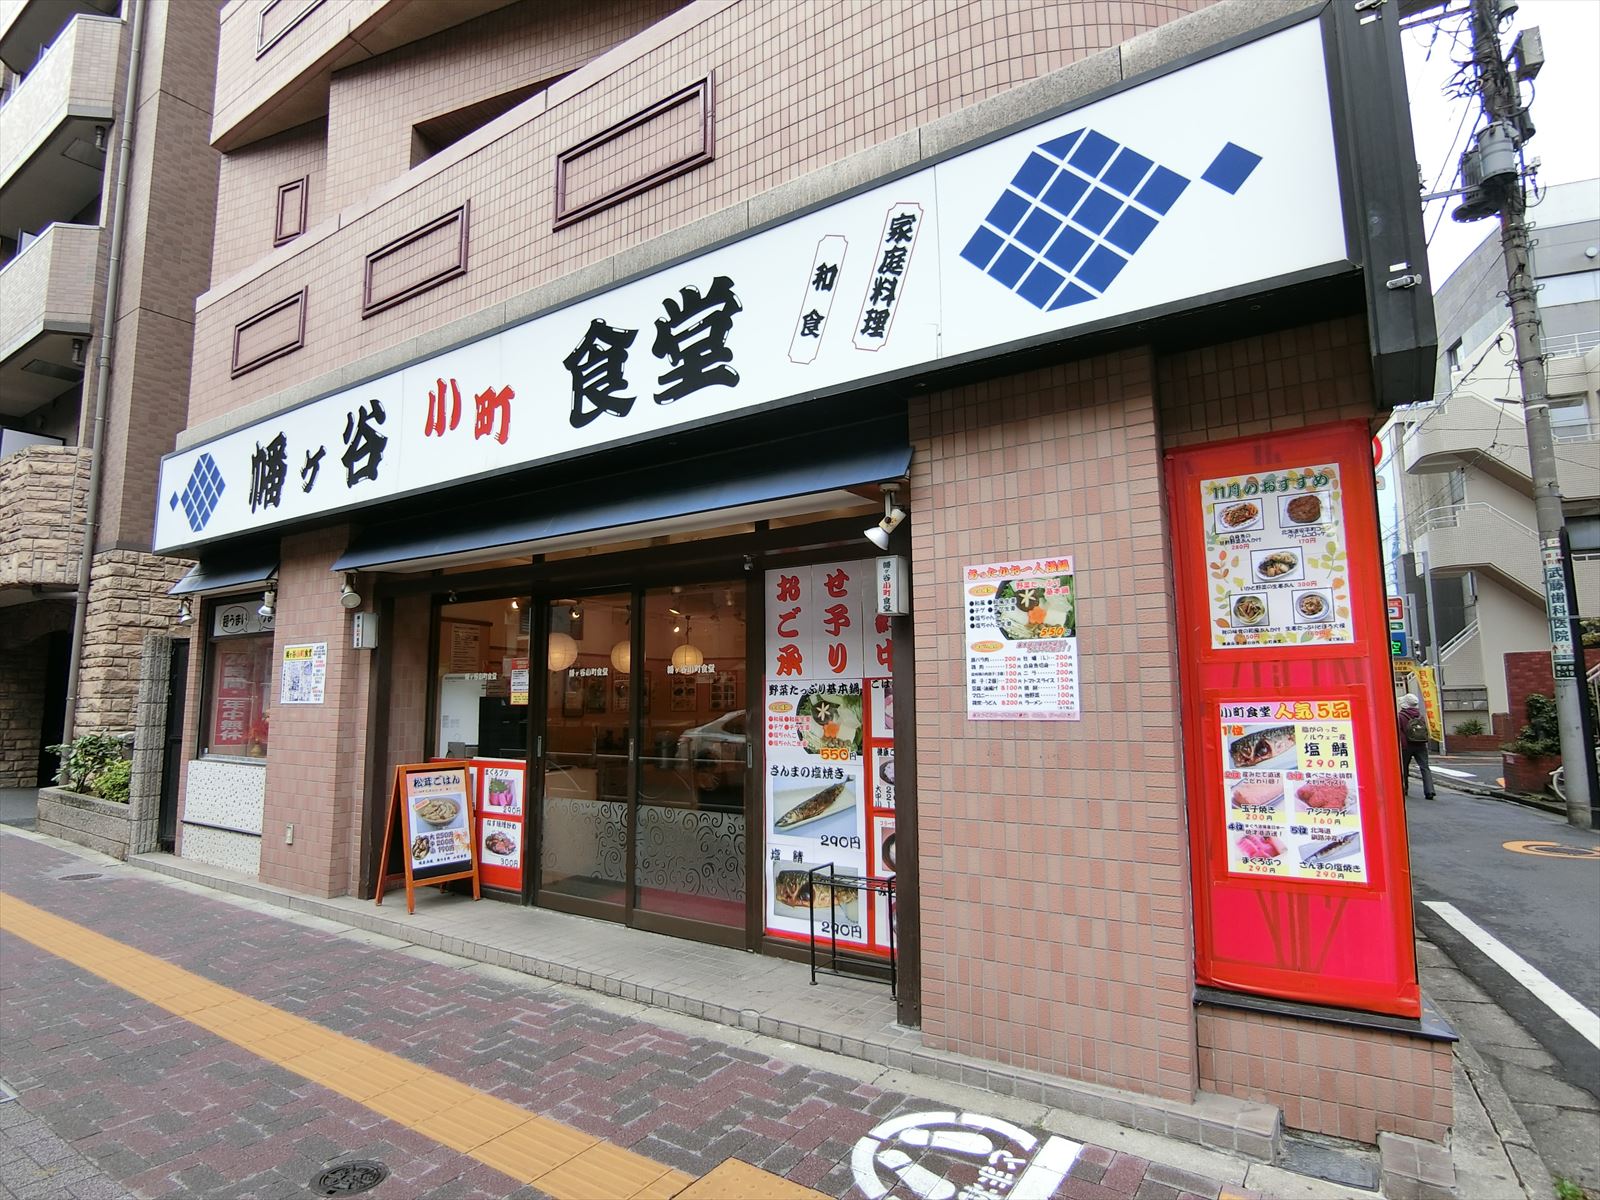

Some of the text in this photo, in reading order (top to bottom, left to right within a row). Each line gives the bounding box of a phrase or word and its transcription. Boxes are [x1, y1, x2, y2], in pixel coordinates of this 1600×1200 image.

[860, 212, 917, 338] 家庭料理
[800, 262, 838, 338] 和食
[248, 275, 744, 514] 幡ヶ谷 小町 食堂
[1213, 474, 1330, 500] 11月のおすすめ
[1548, 566, 1570, 642] 武藤歯科医院
[768, 683, 862, 697] 野菜たっぷり基本鍋
[1220, 706, 1272, 719] 小町食堂
[1222, 725, 1246, 737] 1位
[820, 748, 857, 761] 550円
[770, 765, 845, 780] さんまの塩焼き
[413, 775, 461, 788] 松茸ごはん
[1241, 804, 1276, 814] 玉子焼き
[1305, 807, 1348, 817] アジフライ
[820, 834, 861, 849] 290円
[1241, 856, 1282, 866] まぐろぶつ
[1299, 861, 1362, 873] さんまの塩焼き
